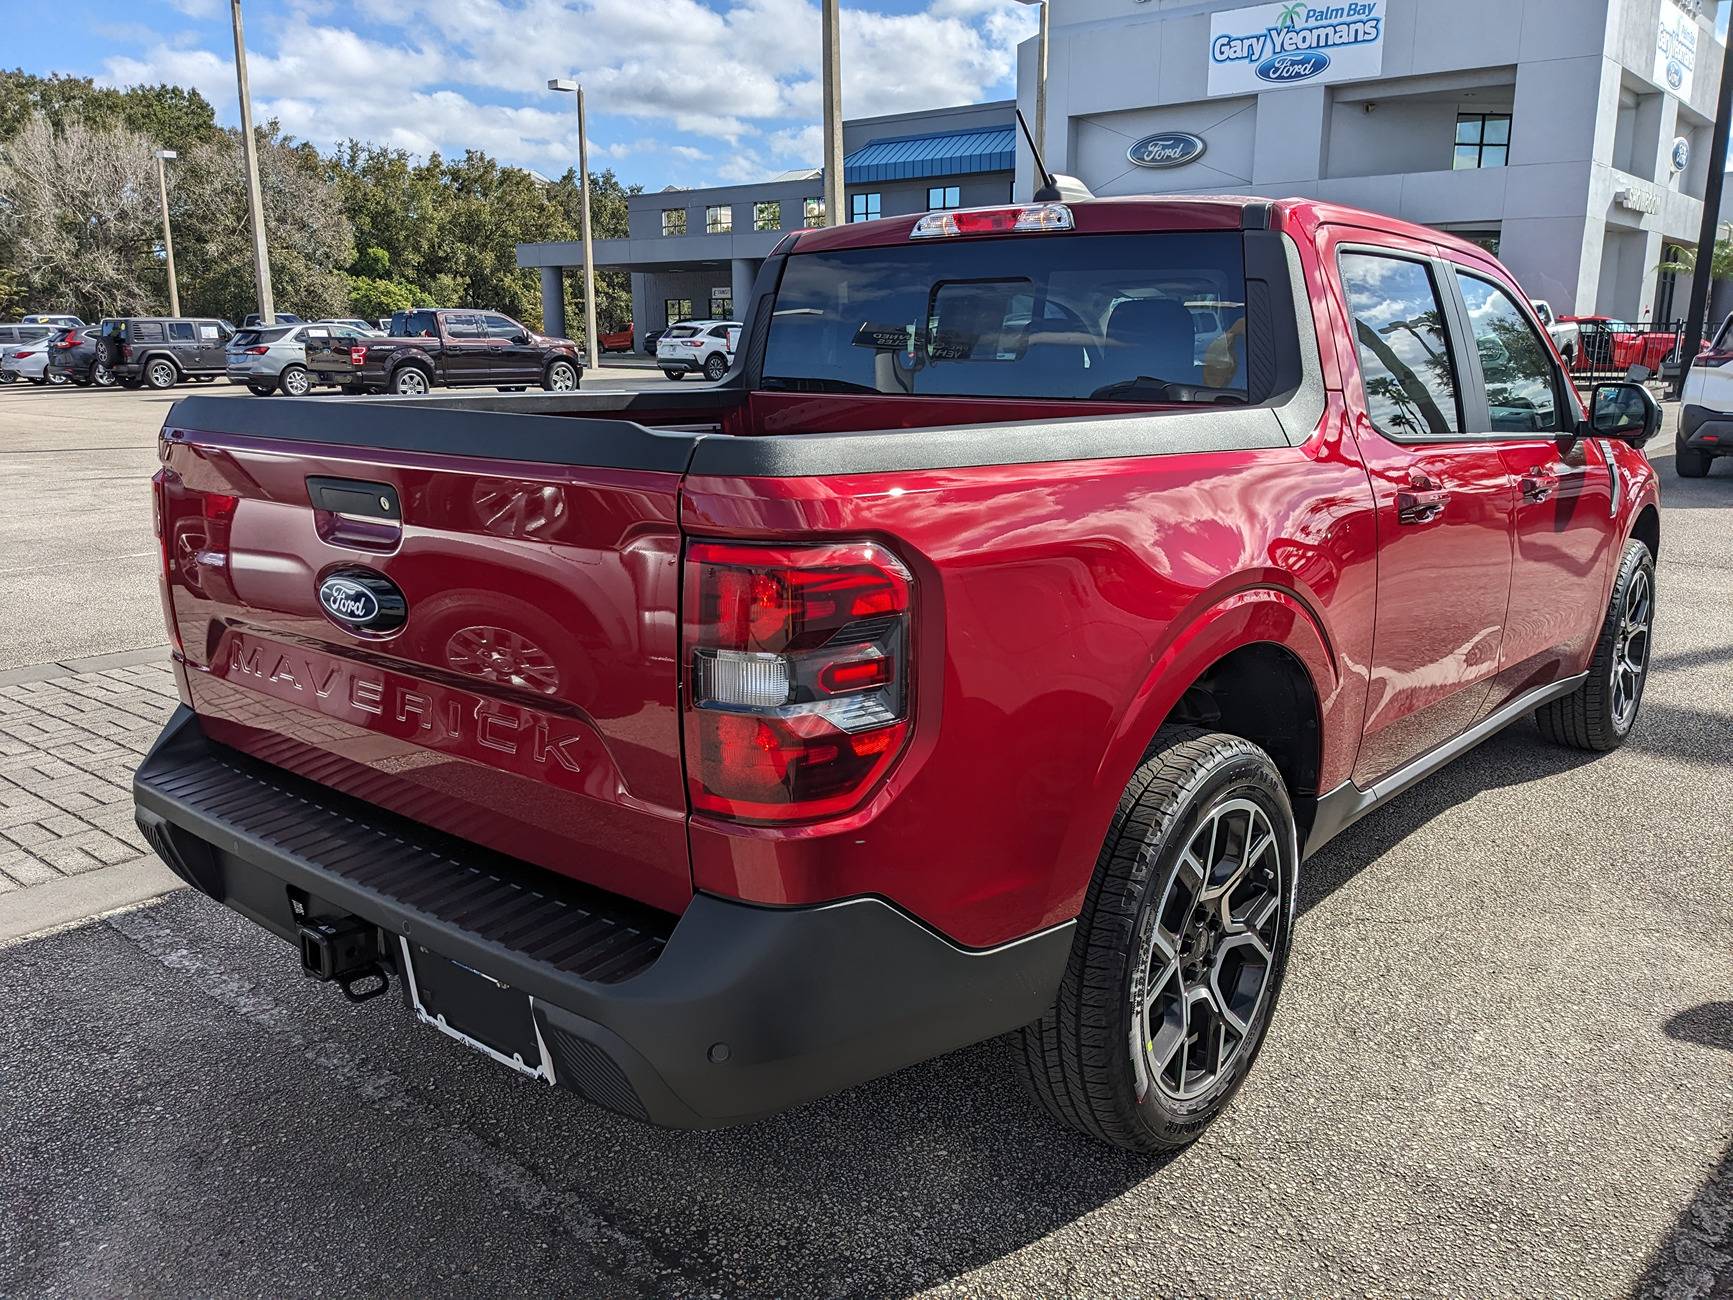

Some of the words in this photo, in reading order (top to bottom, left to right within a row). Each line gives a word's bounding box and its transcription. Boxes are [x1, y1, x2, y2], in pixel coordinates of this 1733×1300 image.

[1305, 7, 1345, 23] Palm
[1346, 3, 1376, 18] Bay
[1213, 35, 1266, 62] Gary
[1268, 18, 1380, 53] Yeomans
[1269, 55, 1315, 79] Ford
[1144, 140, 1184, 161] Ford
[330, 585, 365, 616] Ford
[232, 639, 580, 772] MAVERICK
